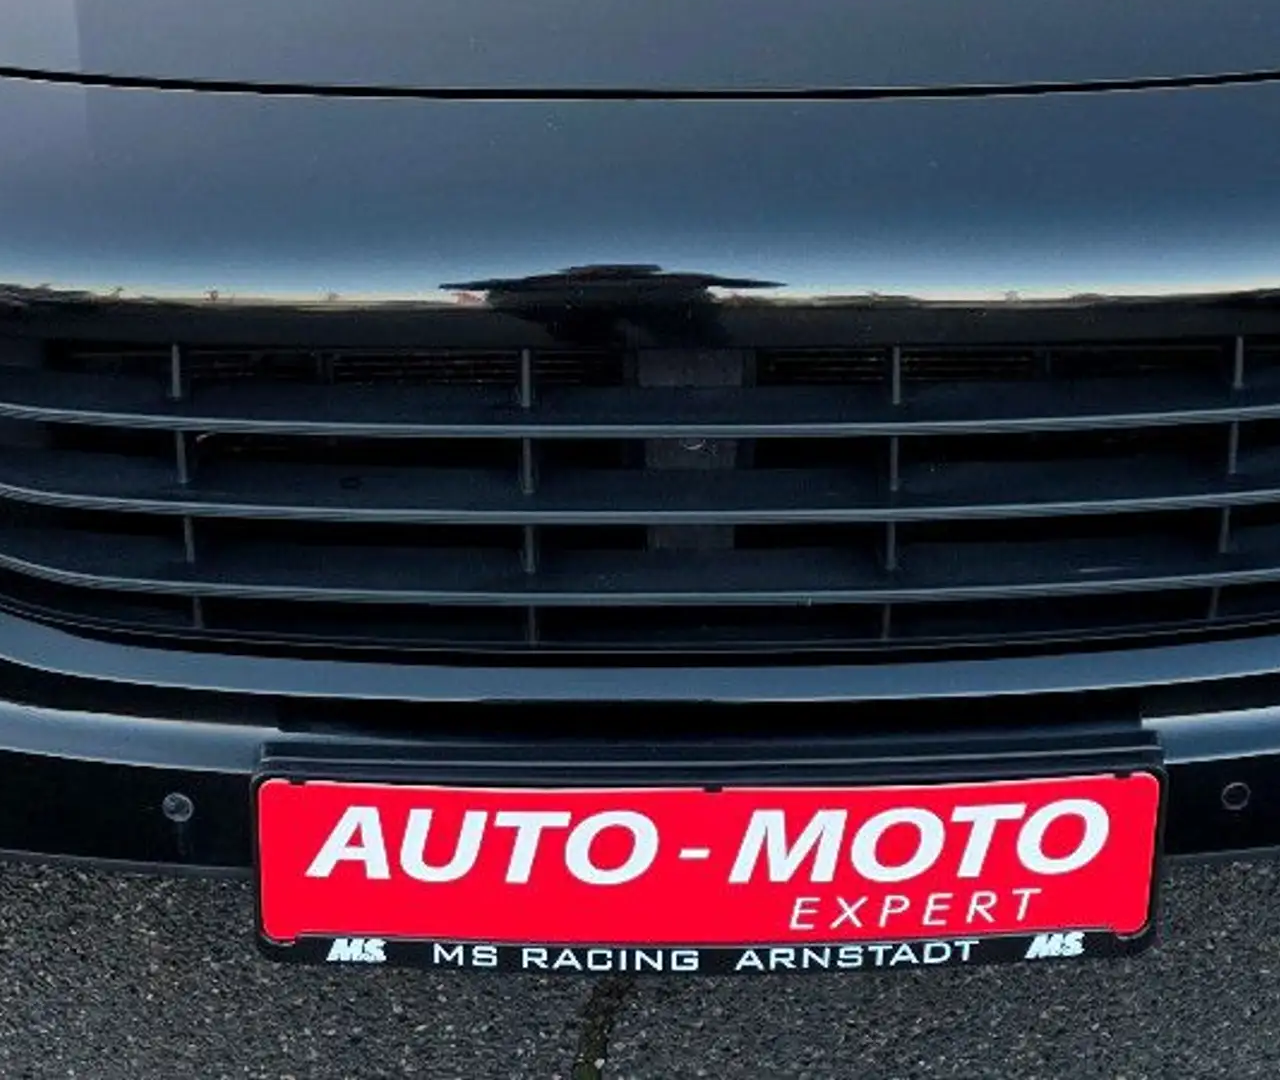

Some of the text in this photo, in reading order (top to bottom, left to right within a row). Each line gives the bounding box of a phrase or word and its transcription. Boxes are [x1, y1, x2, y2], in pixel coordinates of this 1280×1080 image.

[789, 887, 1041, 930] EXPERT
[433, 940, 979, 971] MS RACING ARNSTADT
